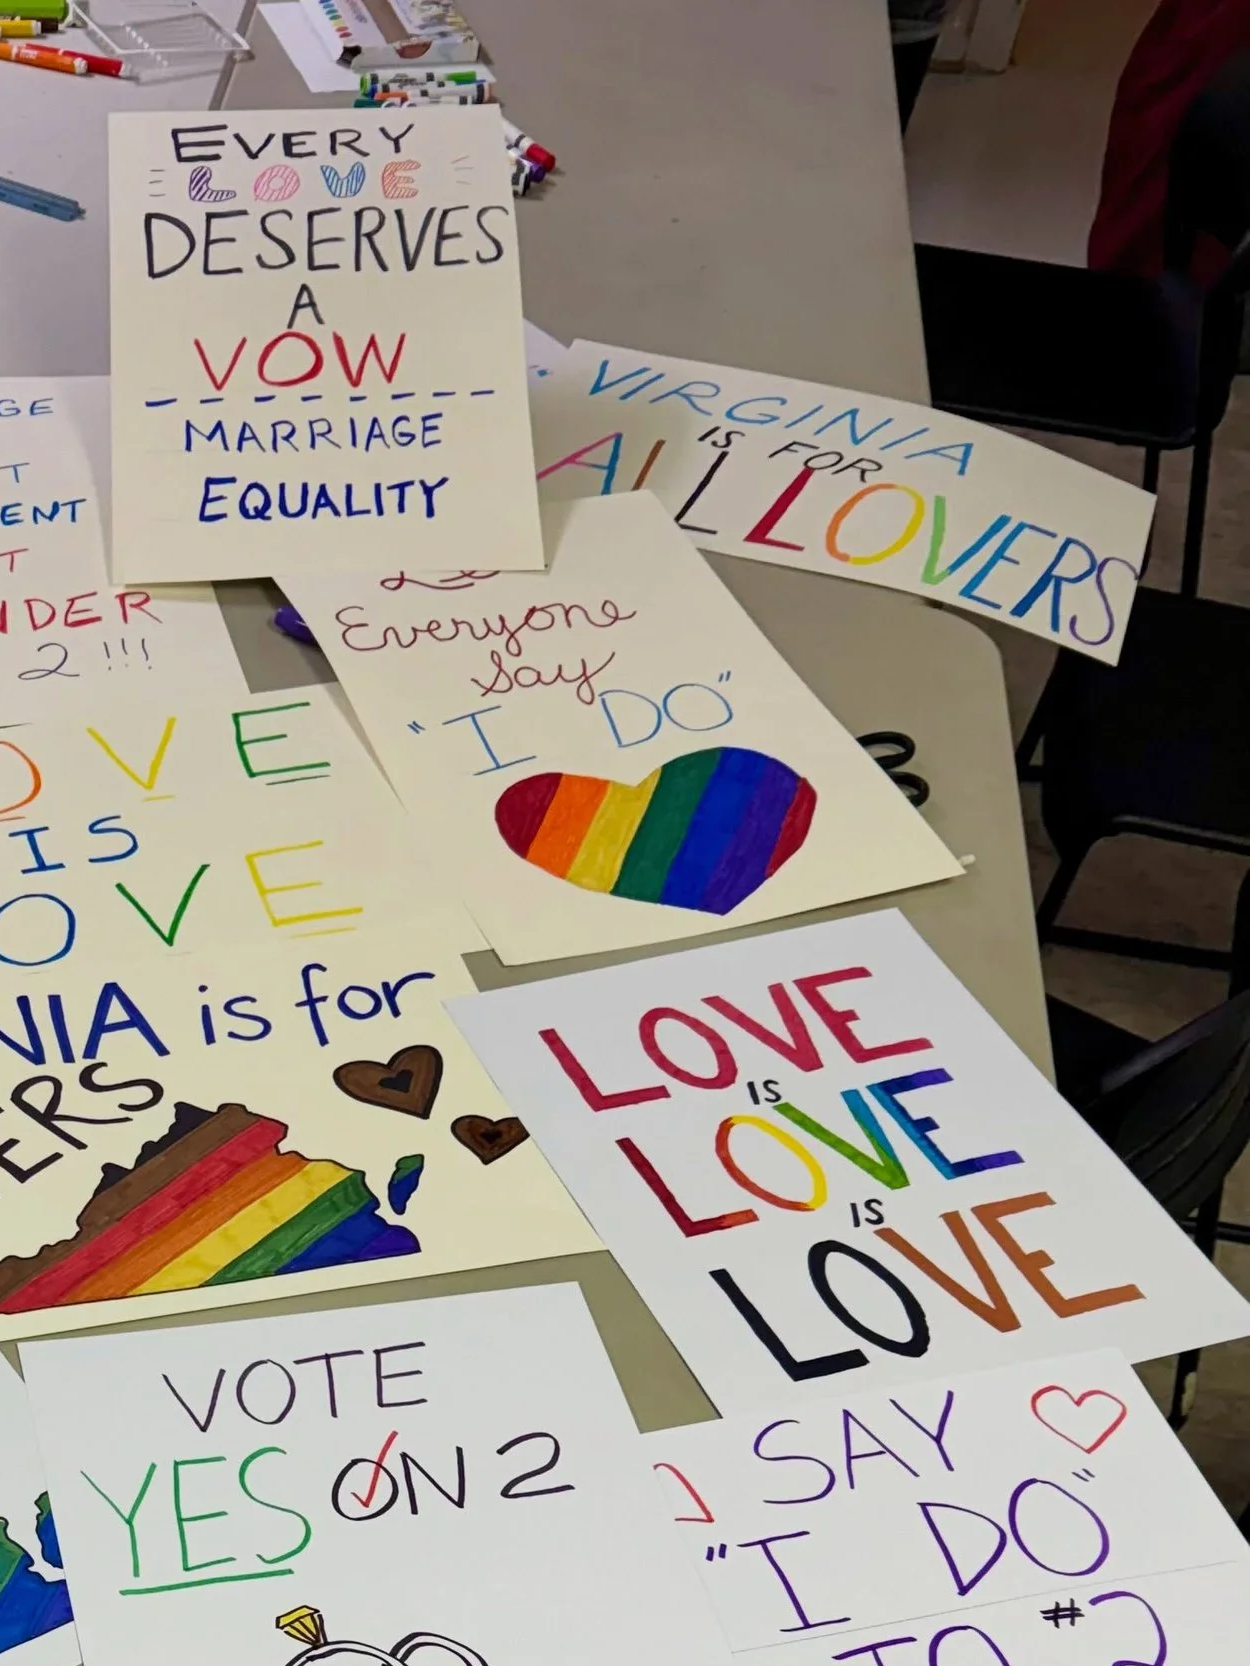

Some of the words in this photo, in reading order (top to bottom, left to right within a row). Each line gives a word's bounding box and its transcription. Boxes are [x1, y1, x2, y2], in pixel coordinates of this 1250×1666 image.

[171, 124, 414, 162] EVERY
[188, 160, 421, 202] LOVE
[145, 205, 509, 279] DESERVES
[287, 283, 324, 329] A
[194, 331, 406, 390] VOW
[185, 413, 443, 453] MARRIAGE
[589, 360, 974, 476] VIRGINIA
[697, 426, 745, 450] IS
[769, 440, 884, 483] FOR
[198, 476, 449, 522] EQUALITY
[743, 466, 1139, 646] LOVERS
[336, 600, 637, 656] Everyone
[9, 815, 139, 874] IS
[197, 984, 272, 1046] is
[294, 962, 436, 1047] for
[538, 965, 934, 1112] LOVE
[747, 1079, 783, 1105] IS
[615, 1068, 1026, 1238] LOVE
[850, 1198, 885, 1228] IS
[709, 1191, 1146, 1382] LOVE
[162, 1341, 428, 1433] VOTE
[753, 1389, 955, 1504] SAY
[80, 1447, 311, 1578] YES
[331, 1432, 465, 1521] ON
[496, 1431, 576, 1499] 2
